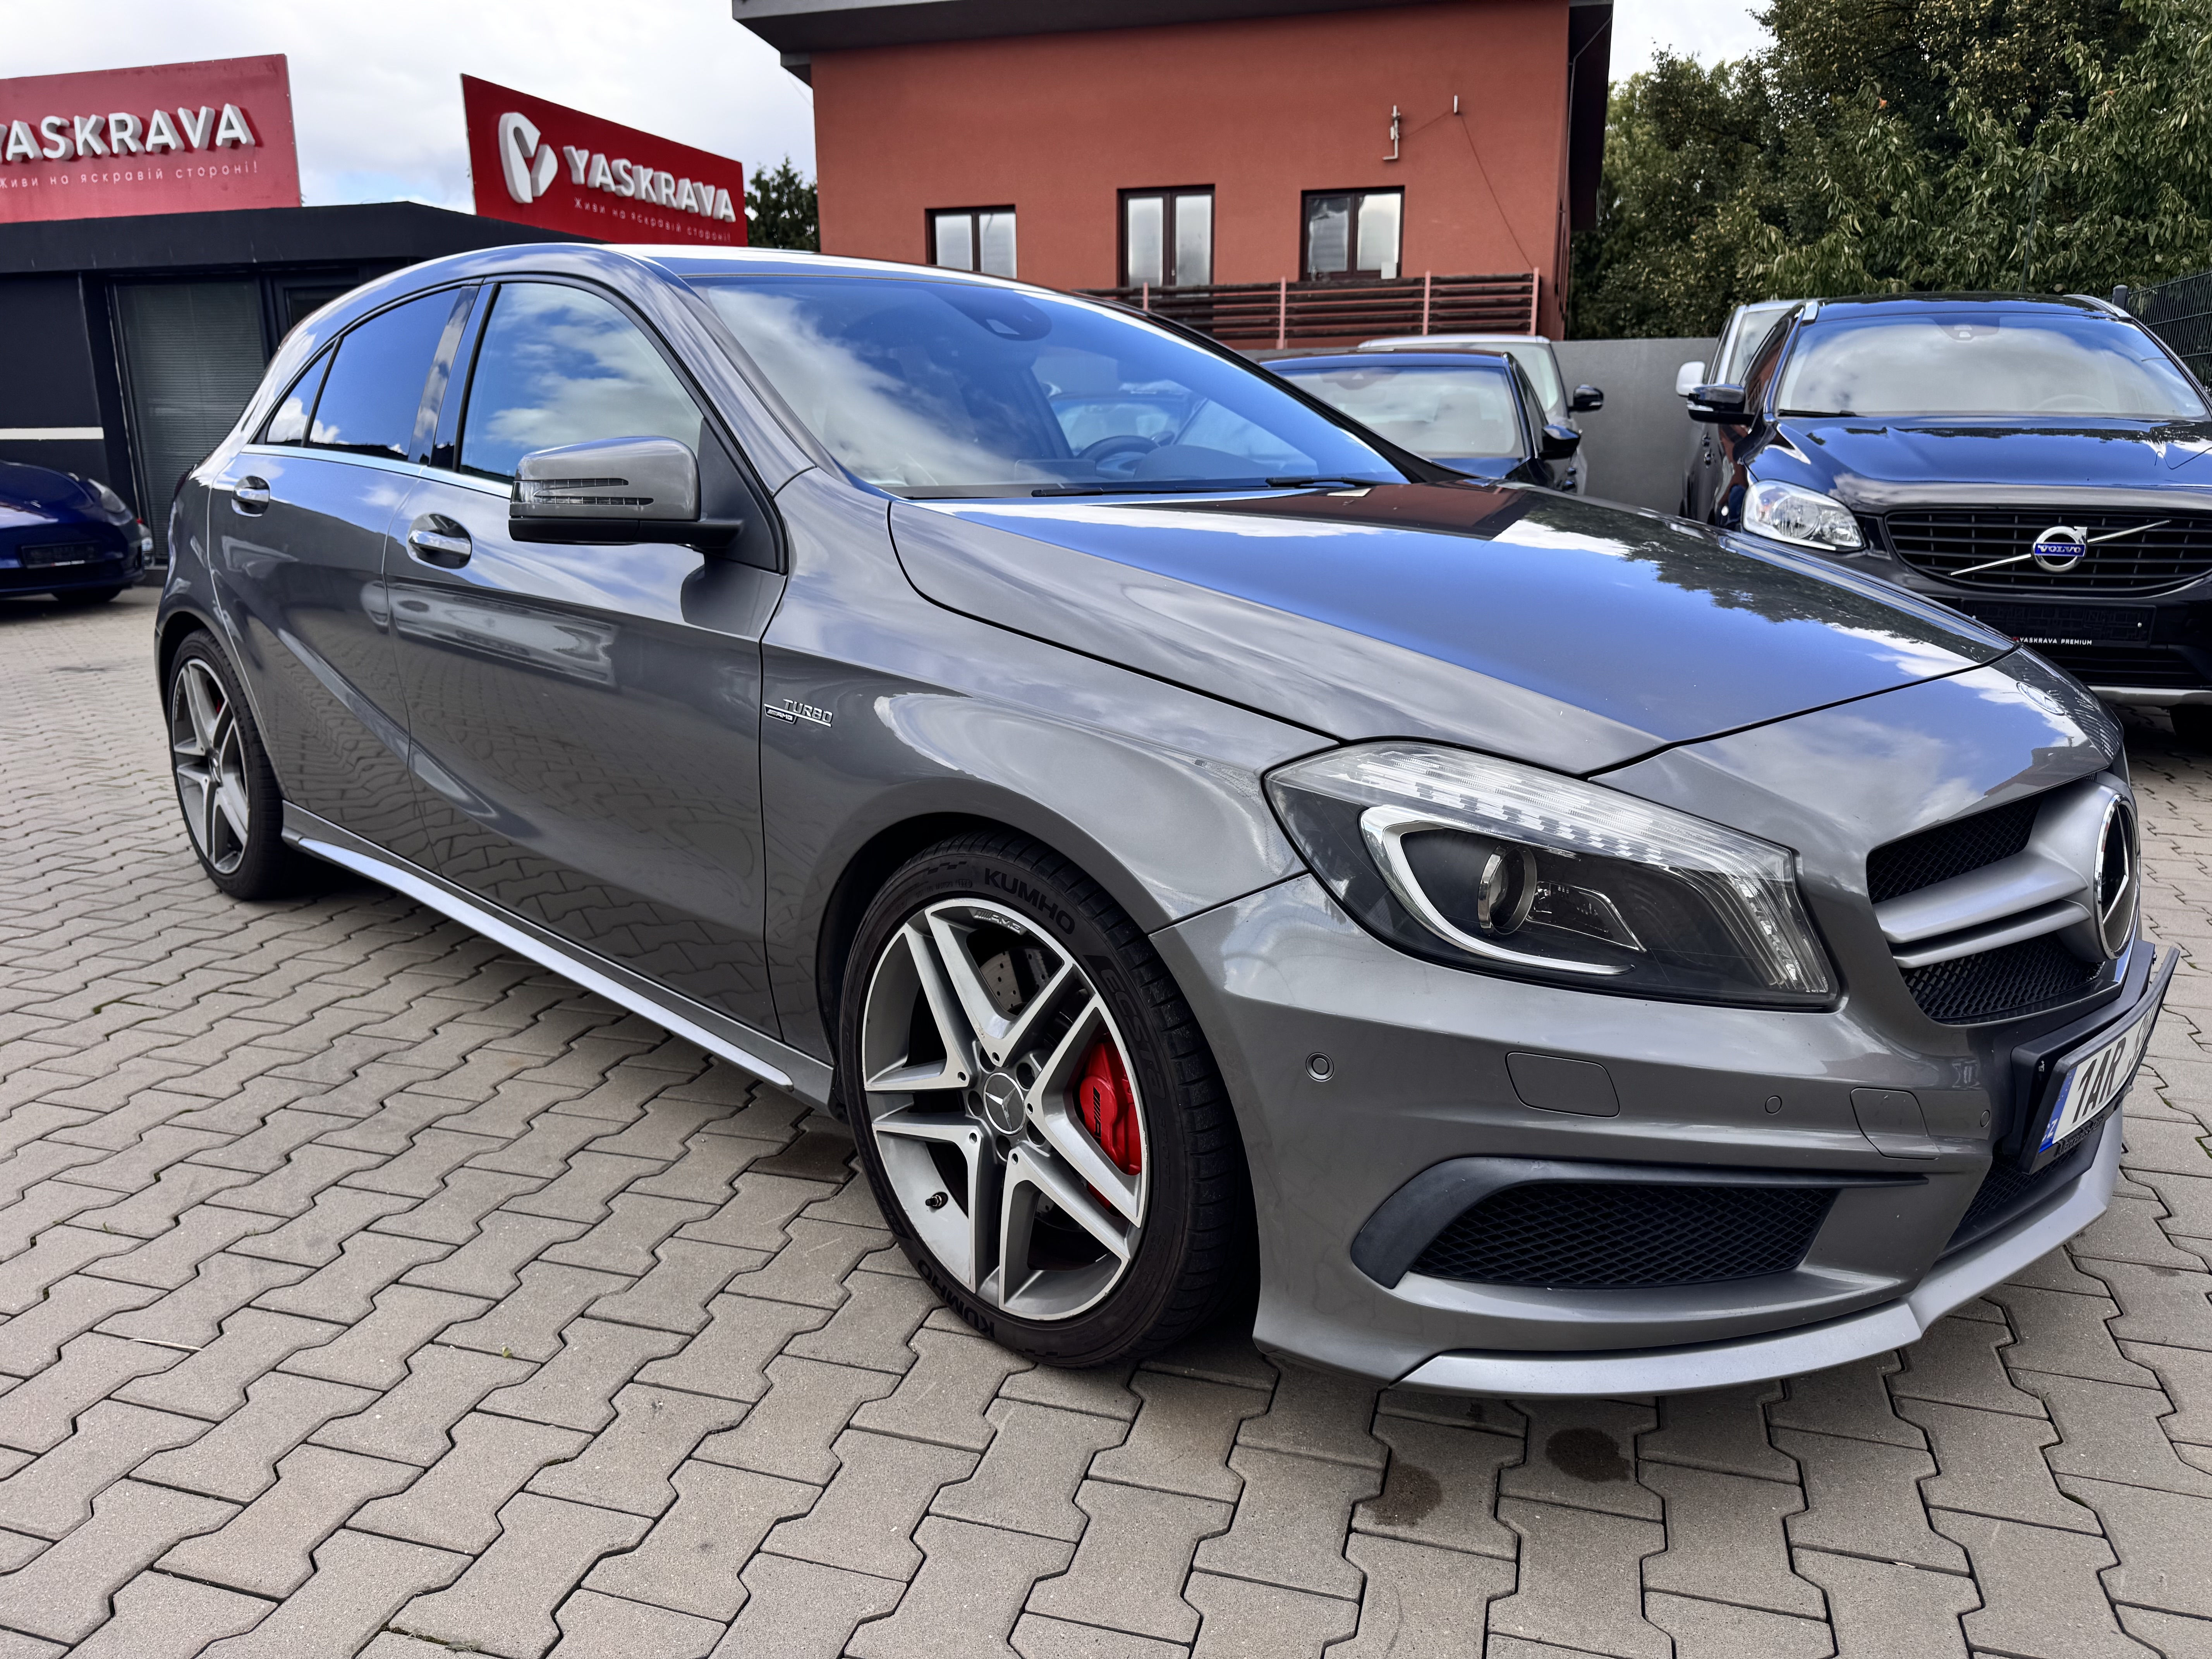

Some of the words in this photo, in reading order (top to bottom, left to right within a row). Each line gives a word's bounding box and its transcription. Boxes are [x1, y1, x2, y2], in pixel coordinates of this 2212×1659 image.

[0, 103, 255, 164] ASKRAVA
[562, 145, 736, 223] YASKRAVA
[2037, 544, 2081, 553] VOLVO
[783, 699, 833, 723] TURBO
[985, 868, 1075, 935] KUMHO
[918, 1260, 995, 1338] KUMHO
